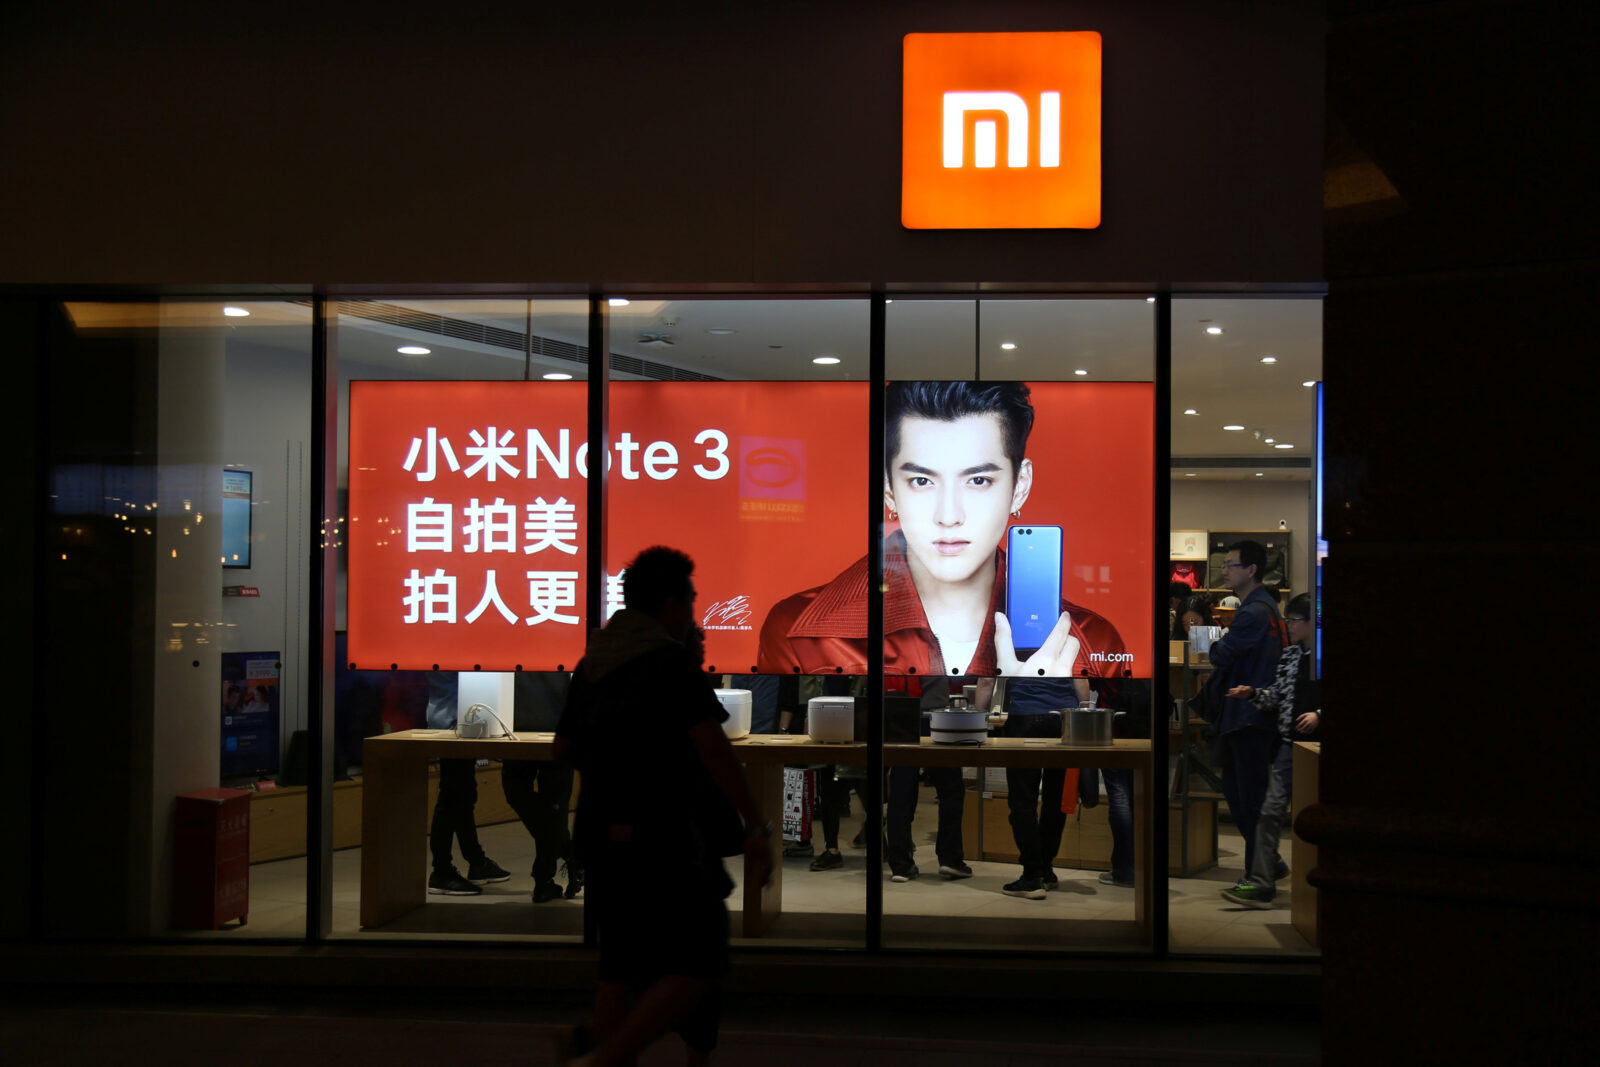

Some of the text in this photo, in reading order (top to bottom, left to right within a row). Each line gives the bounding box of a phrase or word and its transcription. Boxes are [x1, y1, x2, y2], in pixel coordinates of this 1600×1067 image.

[692, 429, 730, 481] 3
[406, 496, 579, 555] 自拍美
[1090, 651, 1134, 662] mi.com
